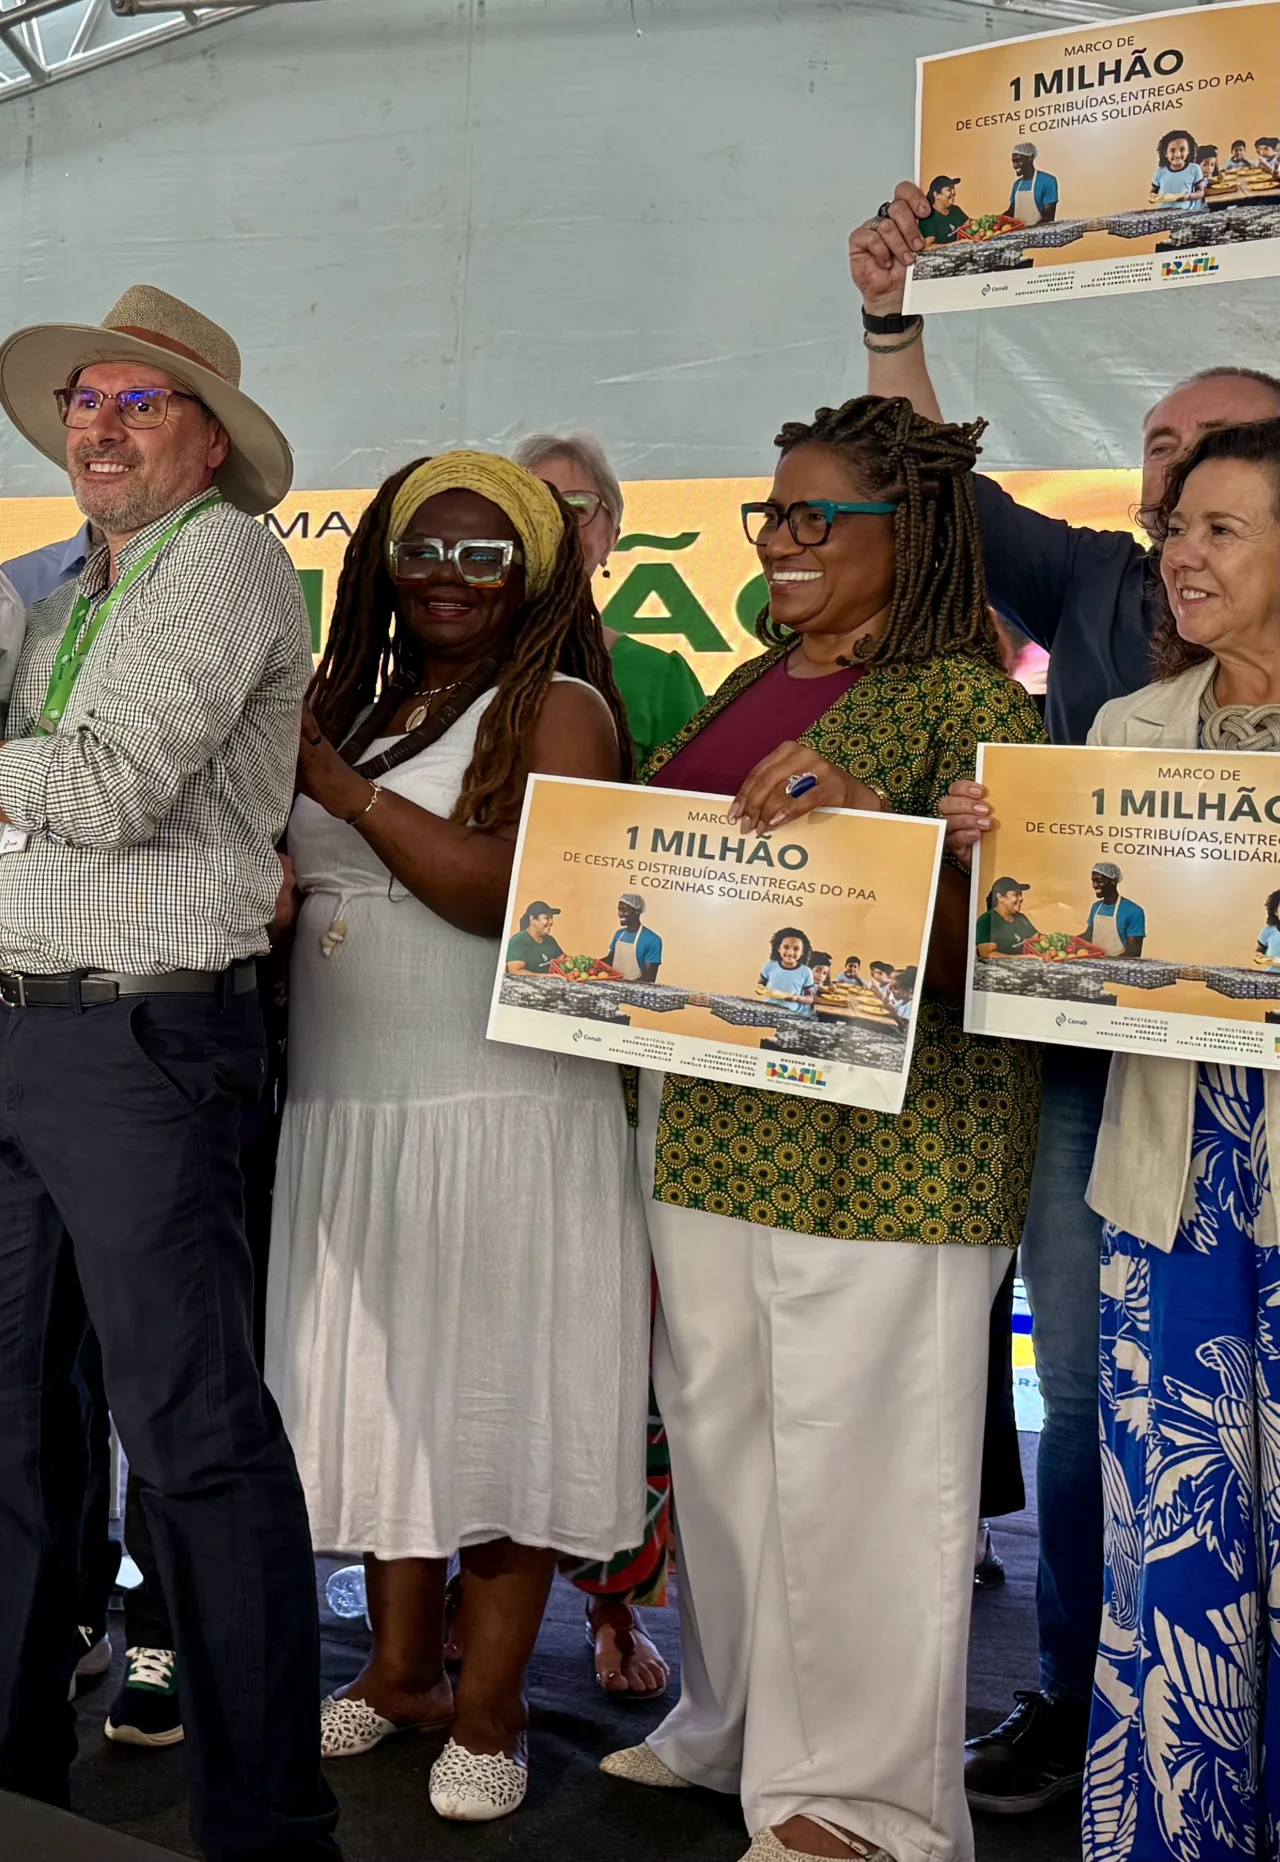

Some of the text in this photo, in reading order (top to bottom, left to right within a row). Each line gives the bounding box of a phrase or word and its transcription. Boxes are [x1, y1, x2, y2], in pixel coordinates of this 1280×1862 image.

[1064, 36, 1134, 57] MARCO DE
[1010, 48, 1183, 101] 1 MILHÃO
[956, 119, 971, 131] DE
[976, 111, 1020, 128] CESTAS
[1198, 77, 1220, 90] DO
[1225, 72, 1254, 85] PAA
[1019, 98, 1183, 135] E COZINHAS SOLIDÁRIAS
[1162, 257, 1219, 276] BRASIL
[1158, 768, 1241, 781] MARCO DE
[1092, 788, 1104, 815] 1
[688, 811, 737, 826] MARCO
[1026, 822, 1044, 833] DE
[1050, 823, 1103, 836] CESTAS
[626, 826, 808, 870] 1 MILHÃO
[1101, 842, 1280, 863] E COZINHAS SOLIDÁRI
[563, 852, 581, 863] DE
[585, 854, 634, 870] CESTAS
[820, 884, 842, 896] DO
[847, 887, 876, 900] PAA
[630, 875, 803, 907] E COZINHAS SOLIDÁRIAS
[766, 1061, 826, 1086] BRASIL
